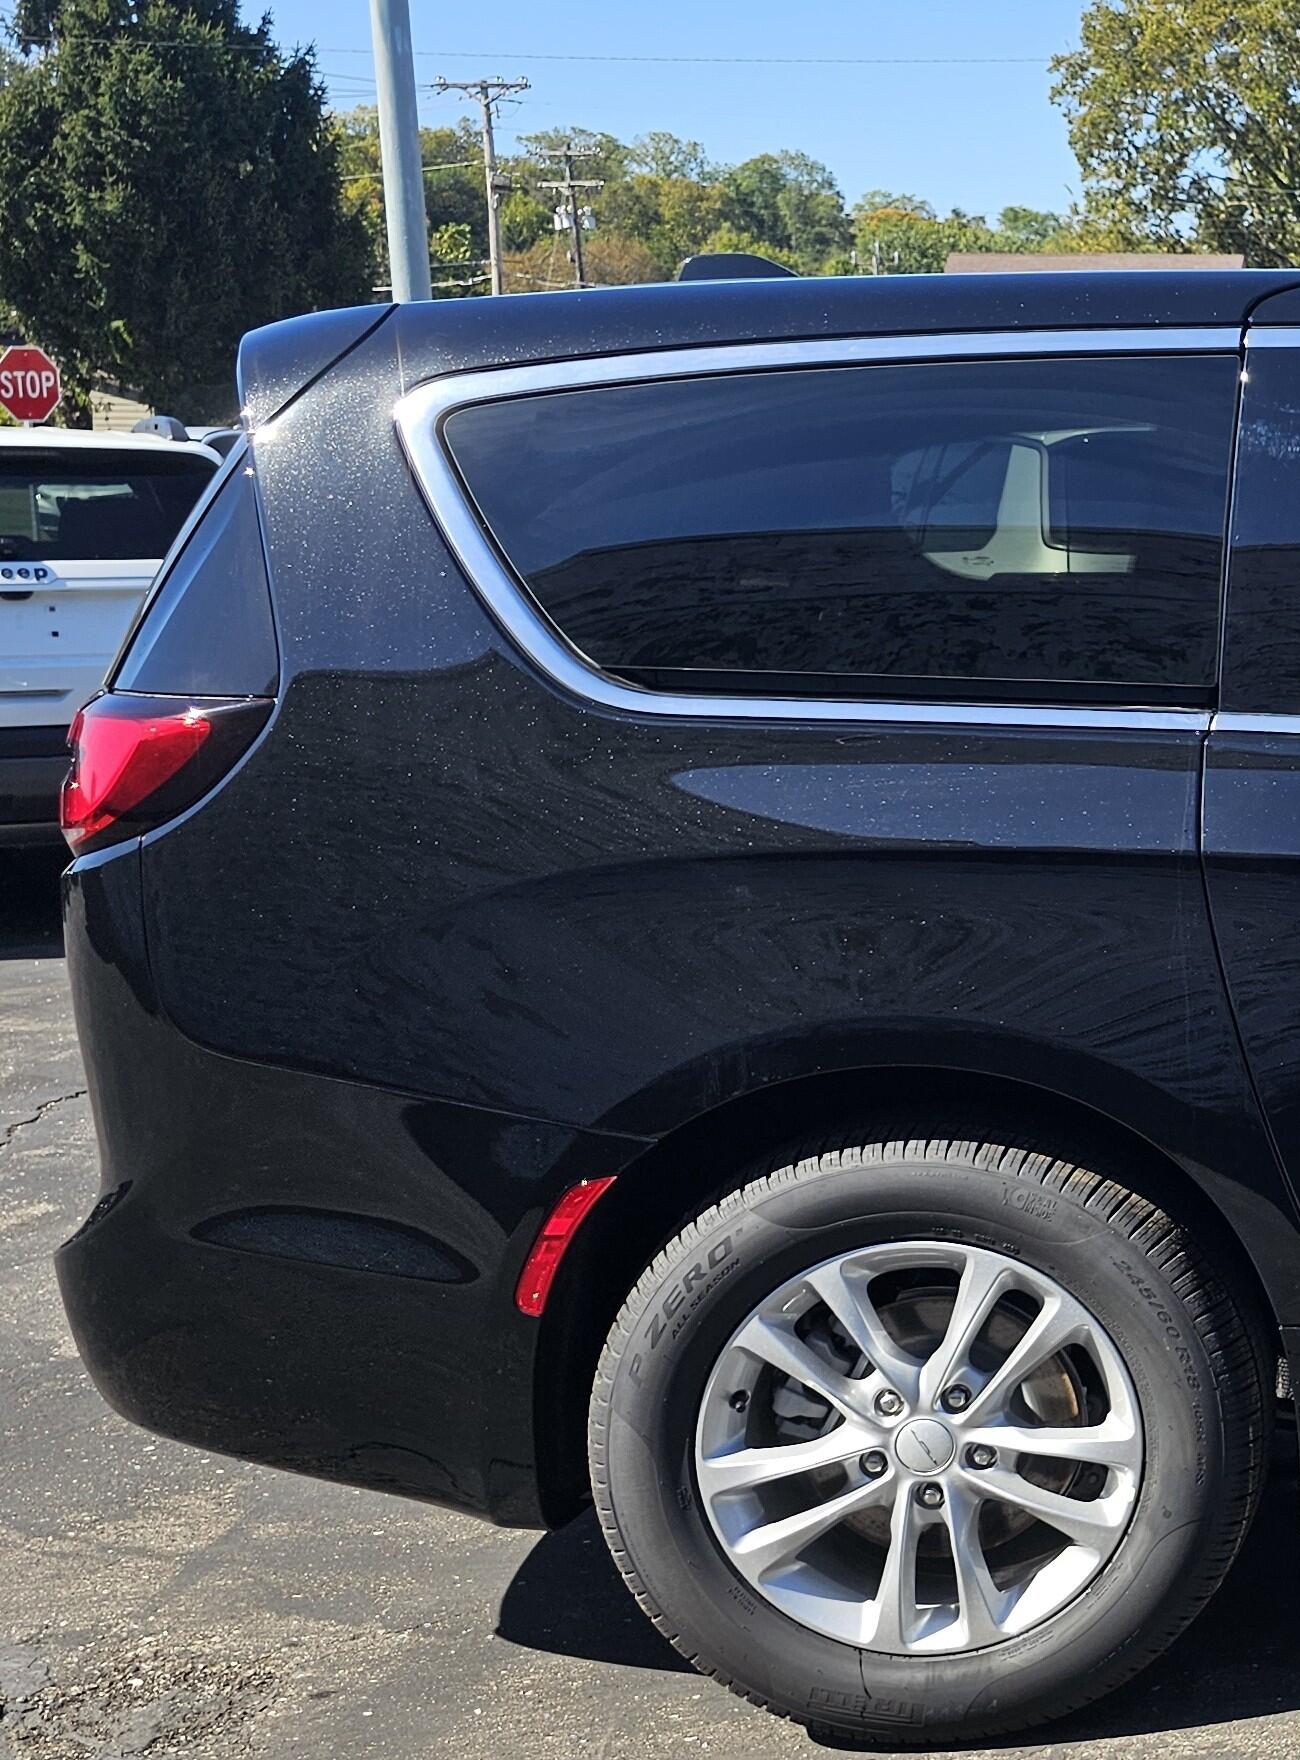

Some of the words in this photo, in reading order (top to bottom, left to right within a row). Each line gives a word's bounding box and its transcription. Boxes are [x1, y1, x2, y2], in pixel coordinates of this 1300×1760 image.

[0, 370, 55, 399] STOP
[1, 567, 48, 581] eep
[629, 1352, 643, 1389] P
[644, 1235, 733, 1350] ZERO
[672, 1313, 691, 1341] ALL
[690, 1257, 741, 1311] SEASON
[1112, 1260, 1181, 1340] 245/60
